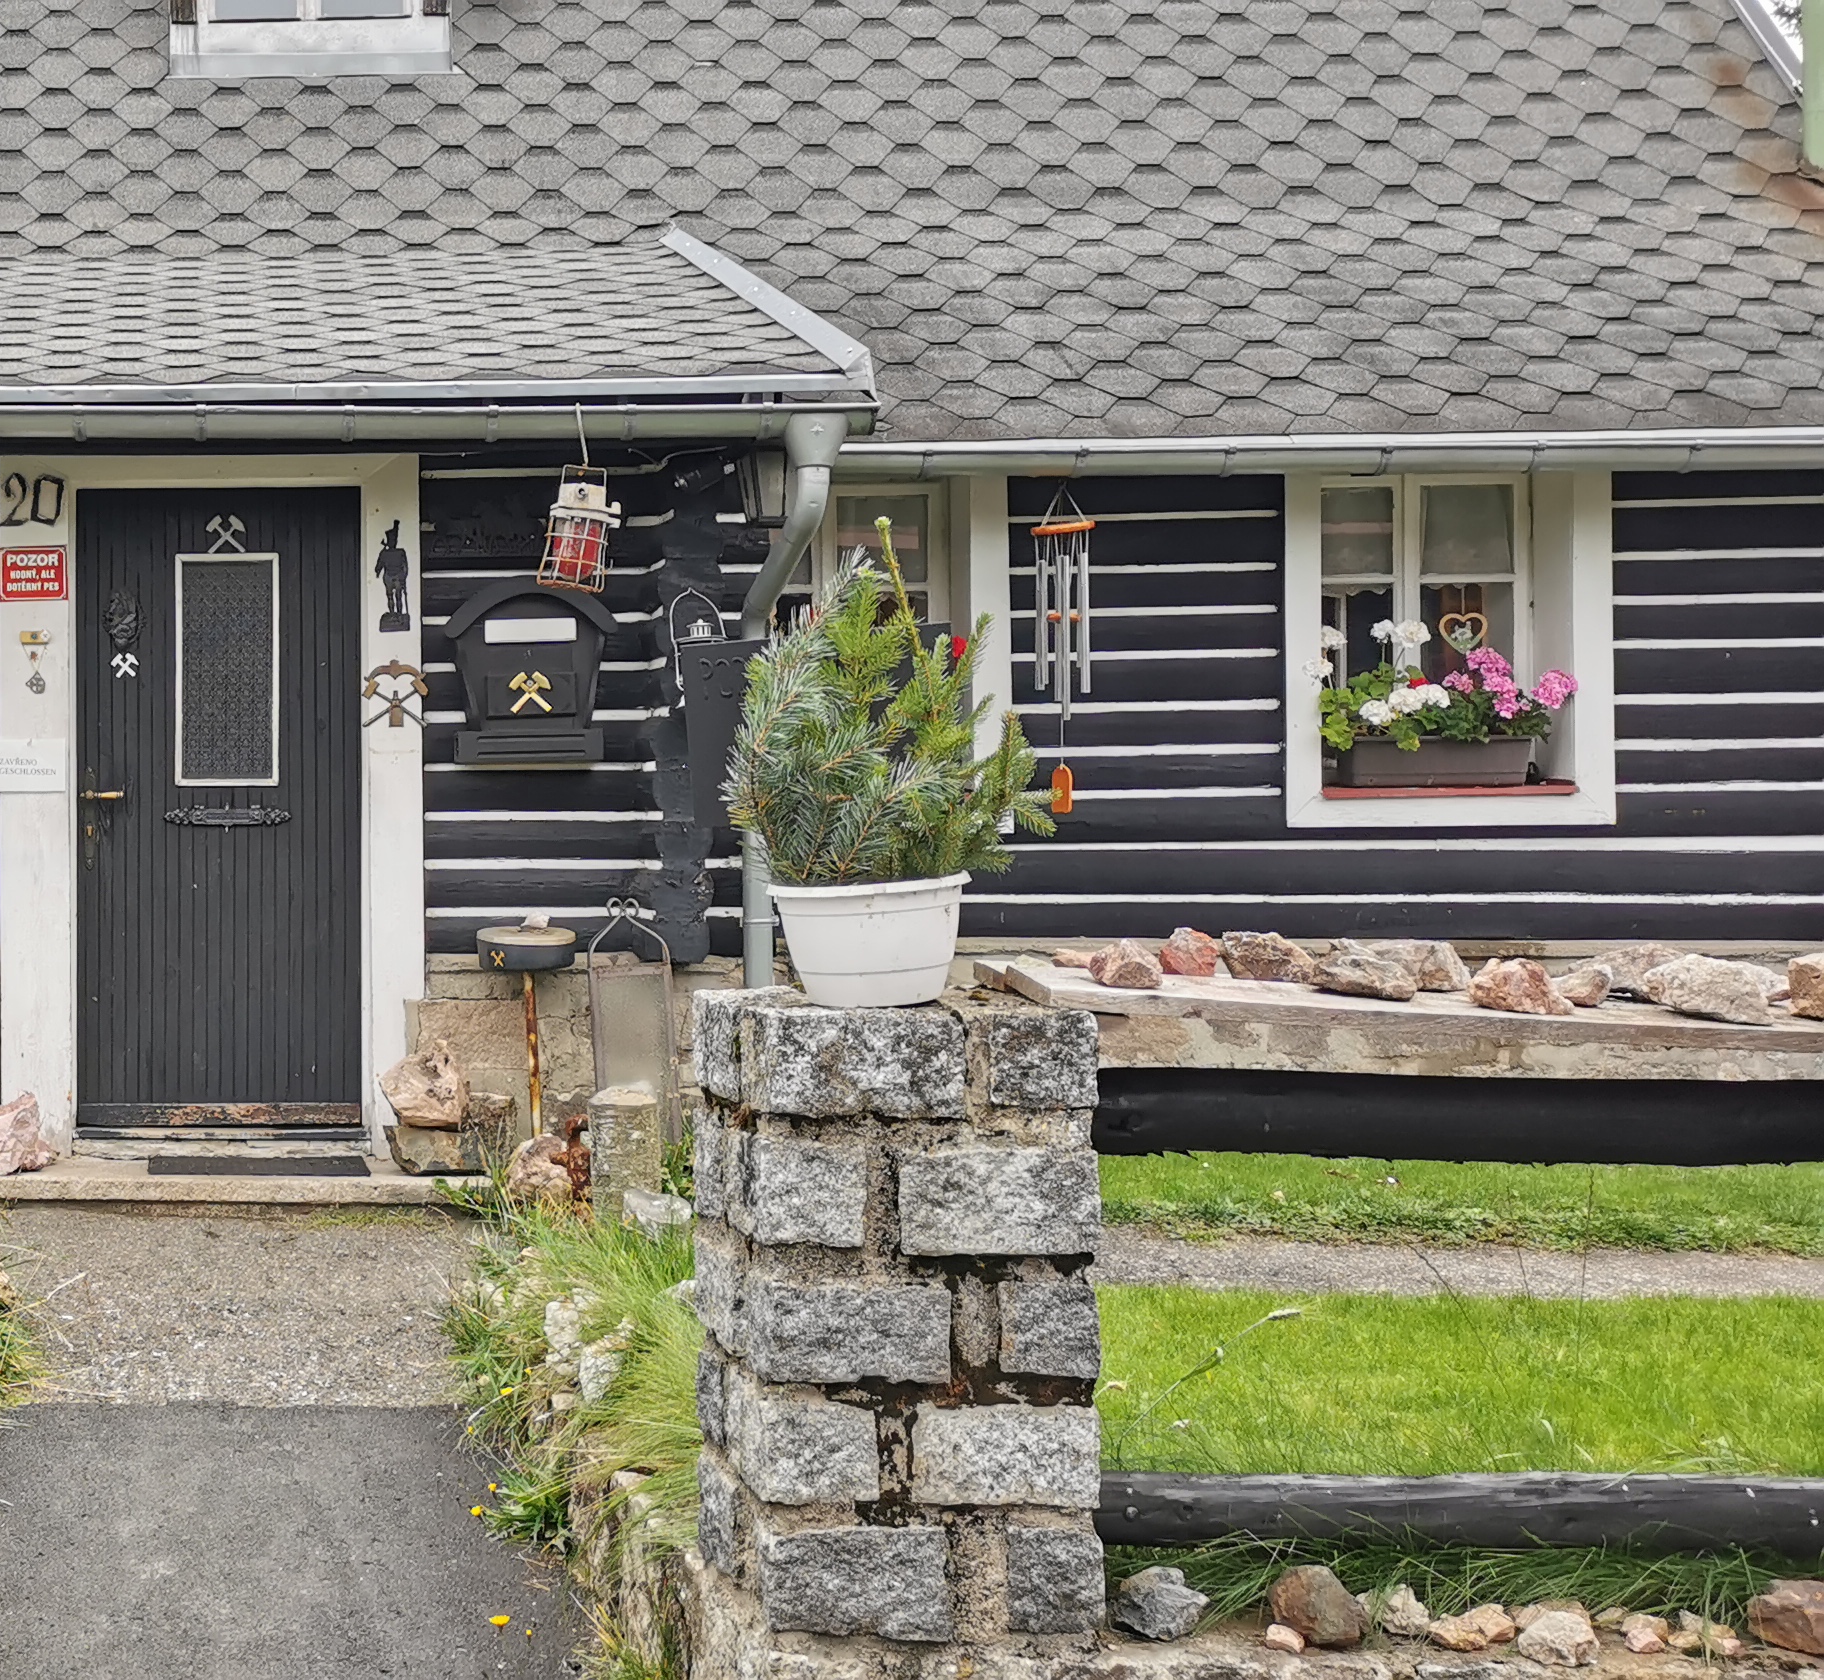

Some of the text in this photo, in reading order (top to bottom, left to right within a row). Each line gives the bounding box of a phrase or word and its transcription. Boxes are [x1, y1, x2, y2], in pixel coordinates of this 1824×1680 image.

[6, 553, 59, 567] POZOR
[40, 569, 56, 579] ALE
[43, 582, 60, 591] PES
[0, 757, 37, 766] ZAVŘENO
[0, 767, 56, 775] GESCHLOSSEN
